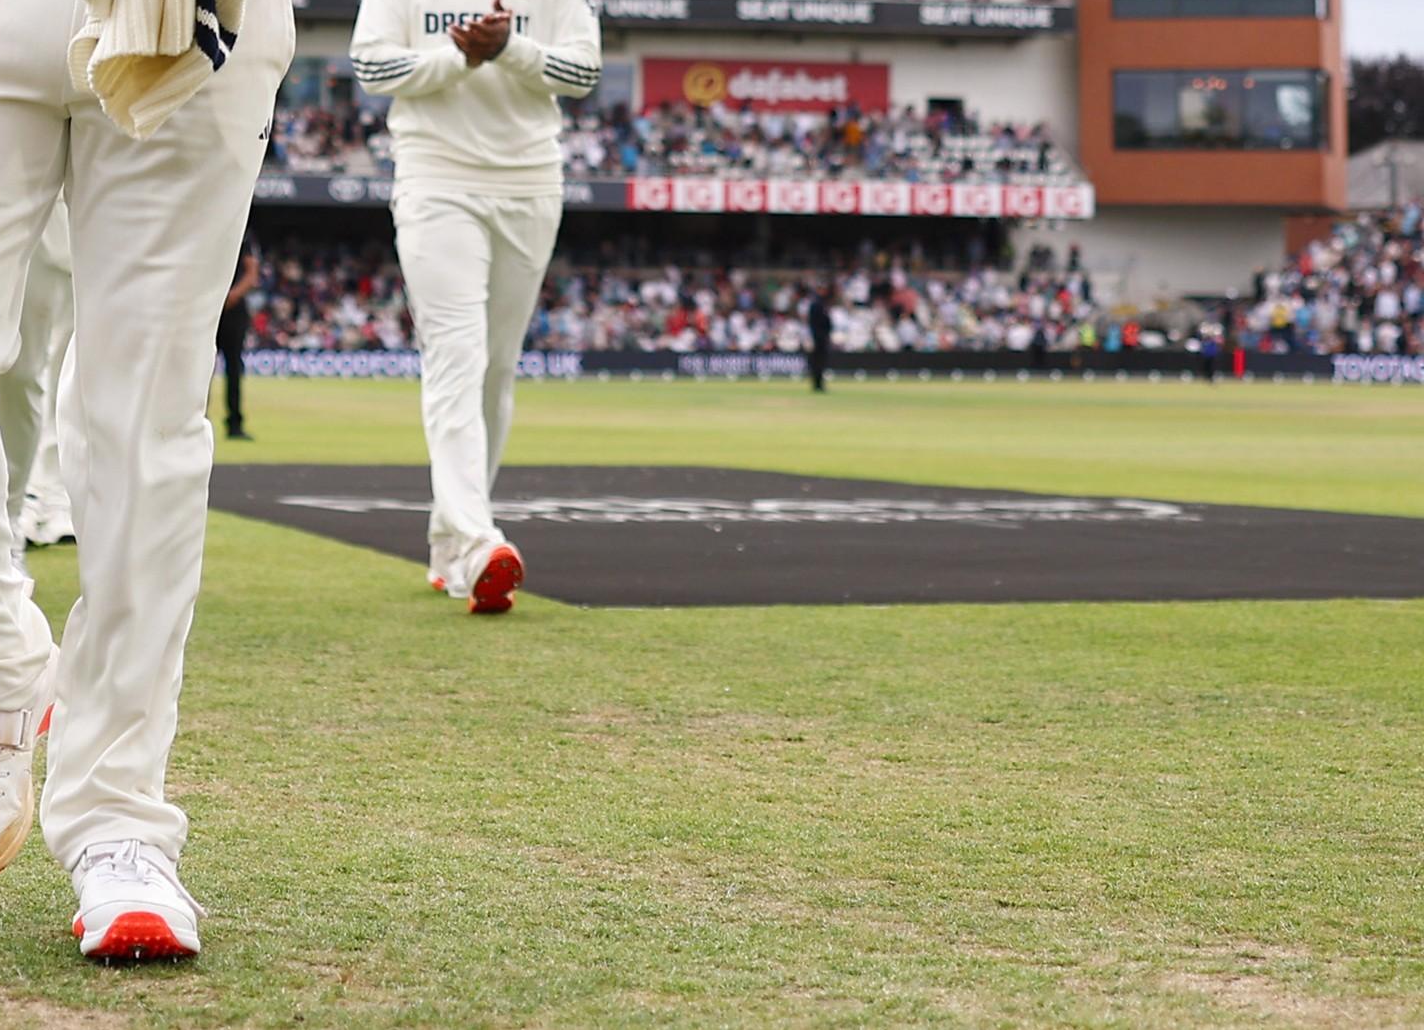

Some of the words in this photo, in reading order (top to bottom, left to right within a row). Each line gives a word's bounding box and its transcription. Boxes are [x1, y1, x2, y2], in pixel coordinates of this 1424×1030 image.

[792, 0, 873, 22] UNIQUE
[920, 3, 970, 25] SEAT
[973, 6, 1053, 28] UNIQUE
[728, 68, 847, 103] dafabet
